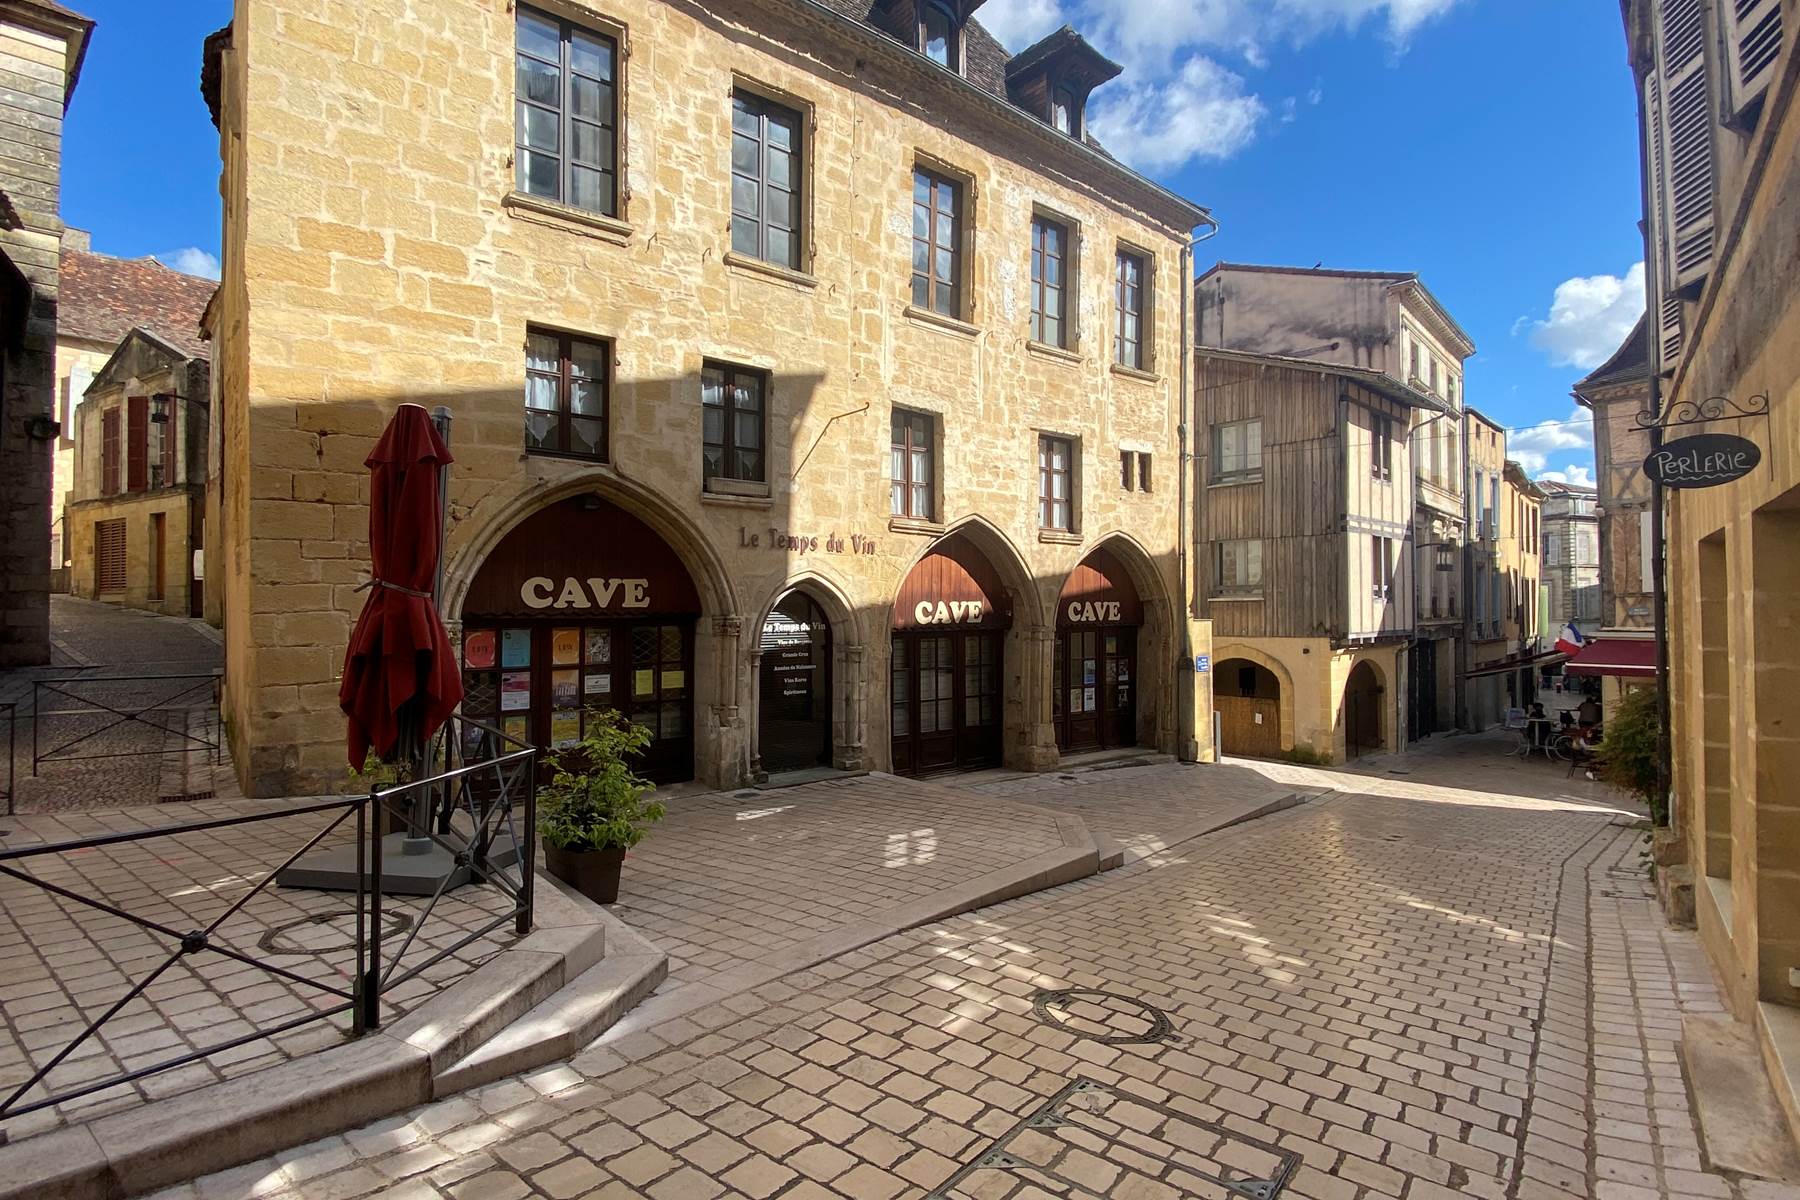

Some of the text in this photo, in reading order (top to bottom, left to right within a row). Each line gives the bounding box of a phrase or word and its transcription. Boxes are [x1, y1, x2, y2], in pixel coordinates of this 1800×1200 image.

[739, 526, 876, 555] Le Temps du Vin
[520, 576, 650, 609] CAVE
[914, 600, 983, 624] CAVE
[1067, 601, 1121, 622] CAVE
[762, 622, 773, 632] Le
[774, 622, 800, 632] Temps
[812, 622, 826, 630] Vin
